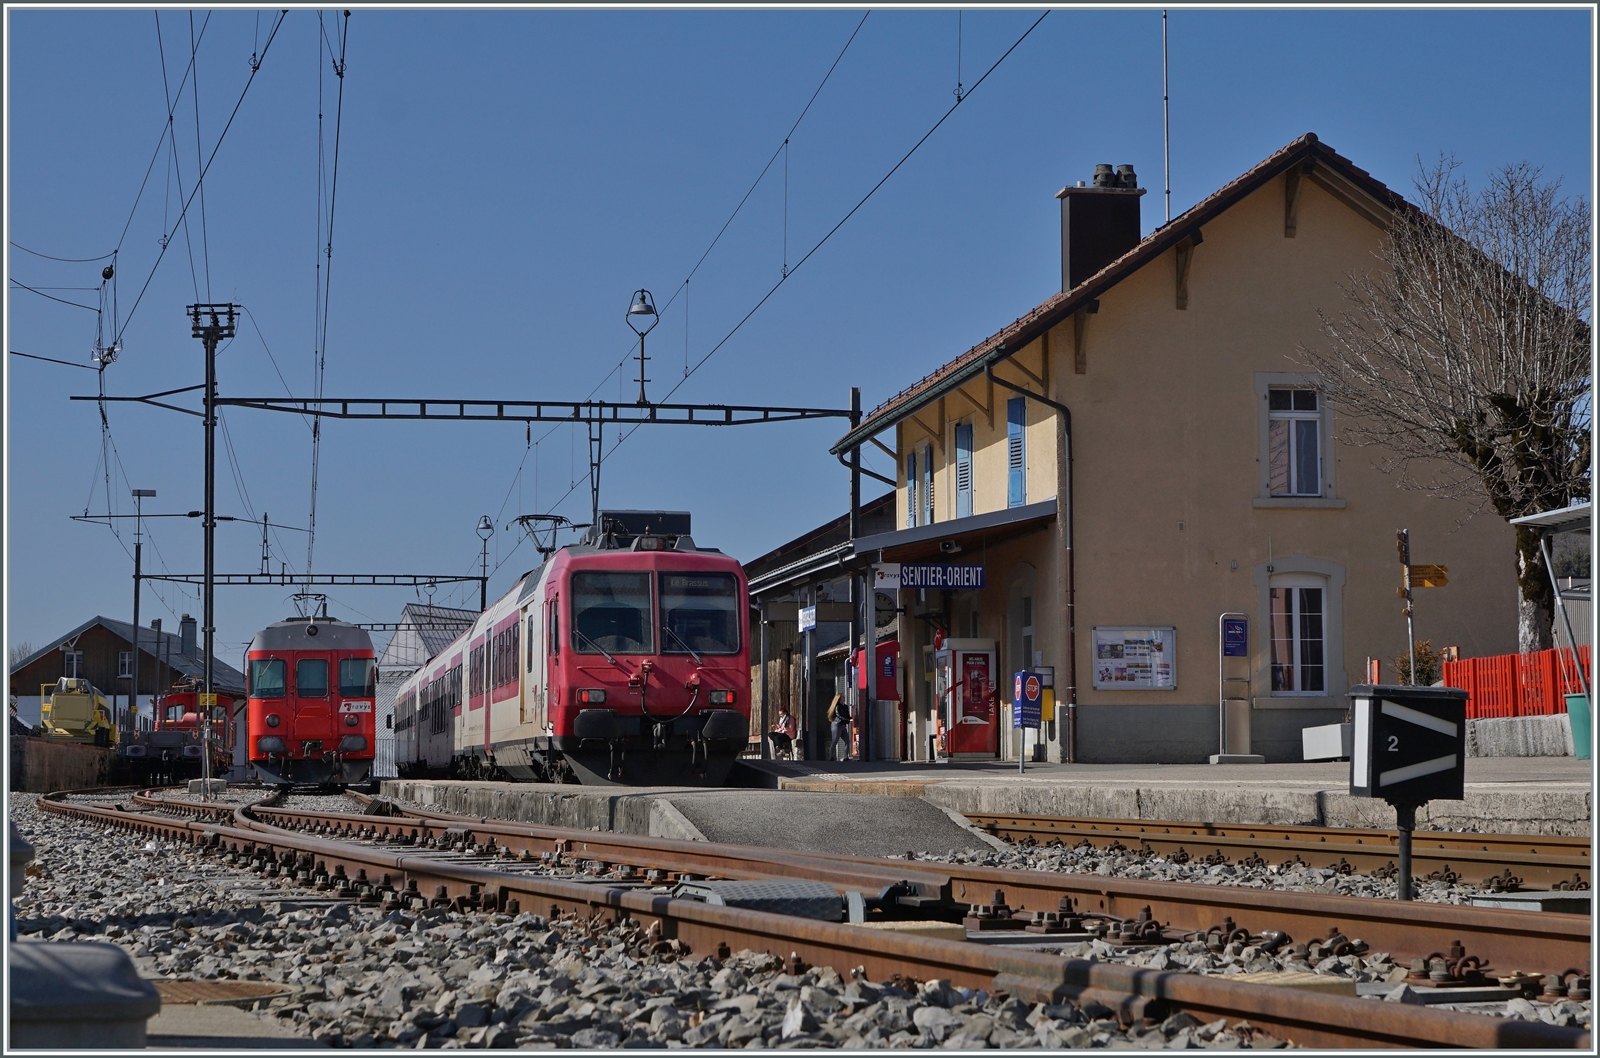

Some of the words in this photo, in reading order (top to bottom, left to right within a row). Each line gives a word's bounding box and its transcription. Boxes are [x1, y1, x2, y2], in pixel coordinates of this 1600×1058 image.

[682, 578, 709, 587] Brassus
[902, 566, 982, 586] SENTIER-ORIENT
[1027, 684, 1038, 692] STOP
[1387, 735, 1399, 752] 2
